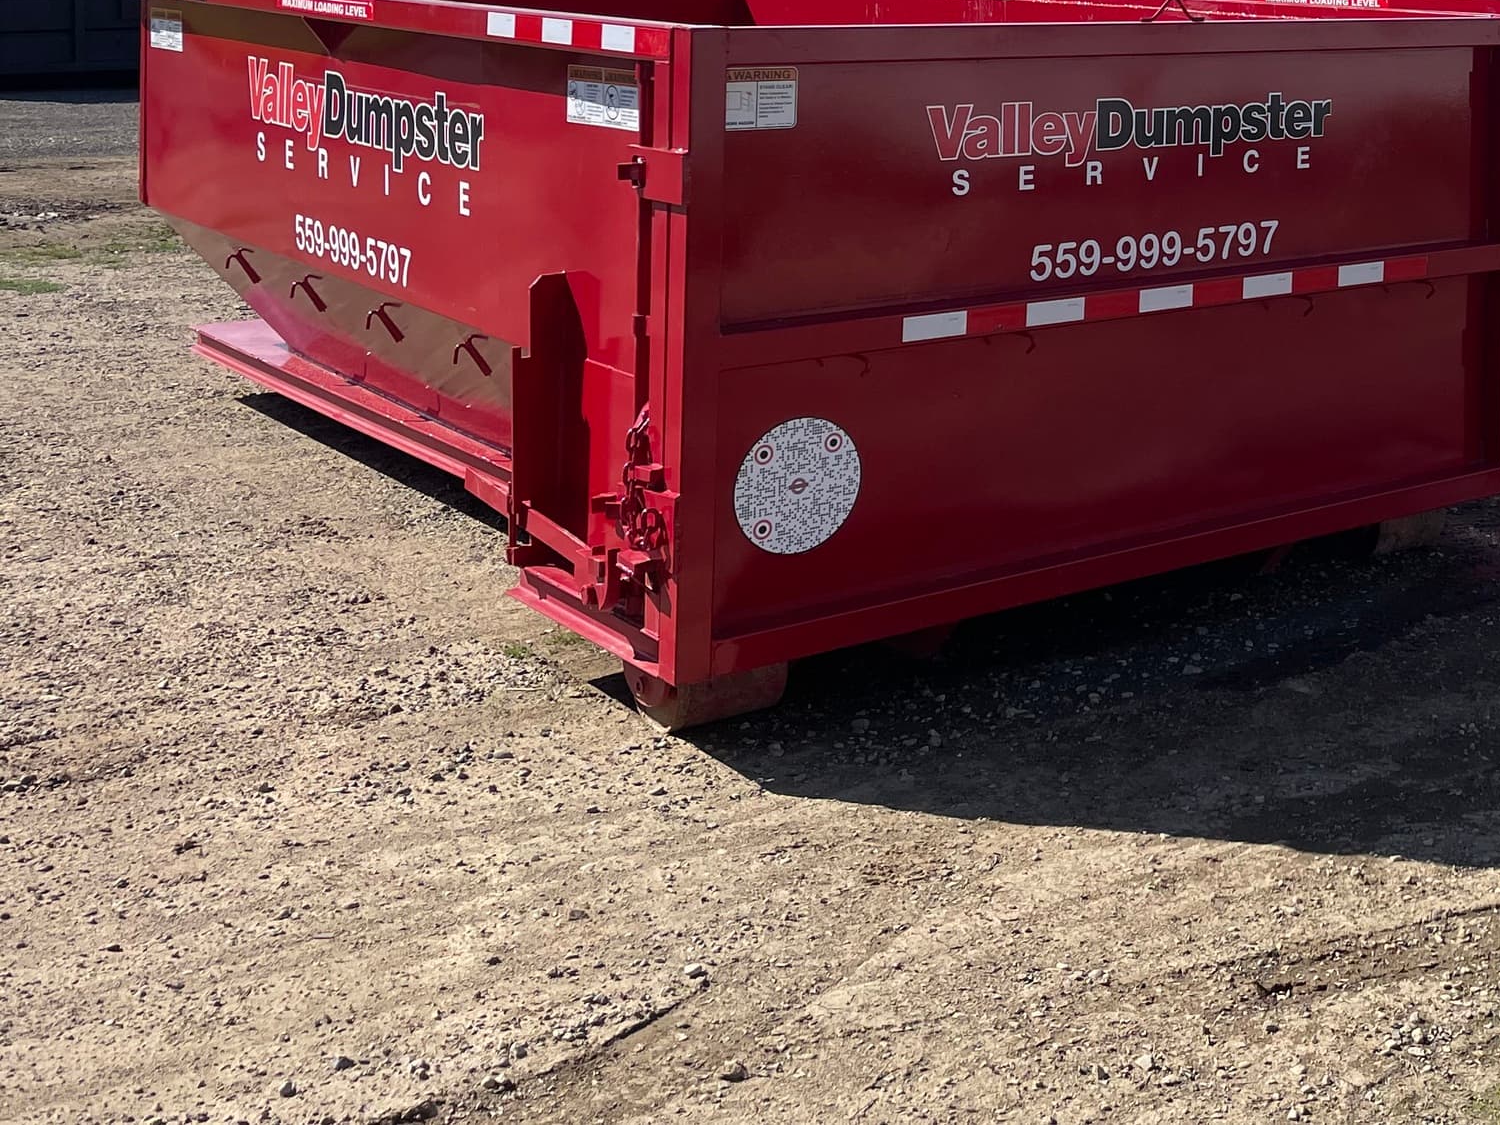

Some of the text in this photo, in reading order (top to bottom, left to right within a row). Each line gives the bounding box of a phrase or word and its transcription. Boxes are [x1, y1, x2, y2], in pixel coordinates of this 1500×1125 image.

[314, 1, 343, 15] LOADING
[345, 5, 367, 18] LEVEL
[734, 70, 791, 81] WARNING
[247, 55, 484, 174] ValleyDumpster
[926, 92, 1332, 167] ValleyDumpster
[256, 131, 471, 217] SERVICE
[951, 146, 1311, 196] SERVICE
[295, 213, 412, 288] 559-999-5797
[1029, 220, 1280, 282] 559-999-5797
